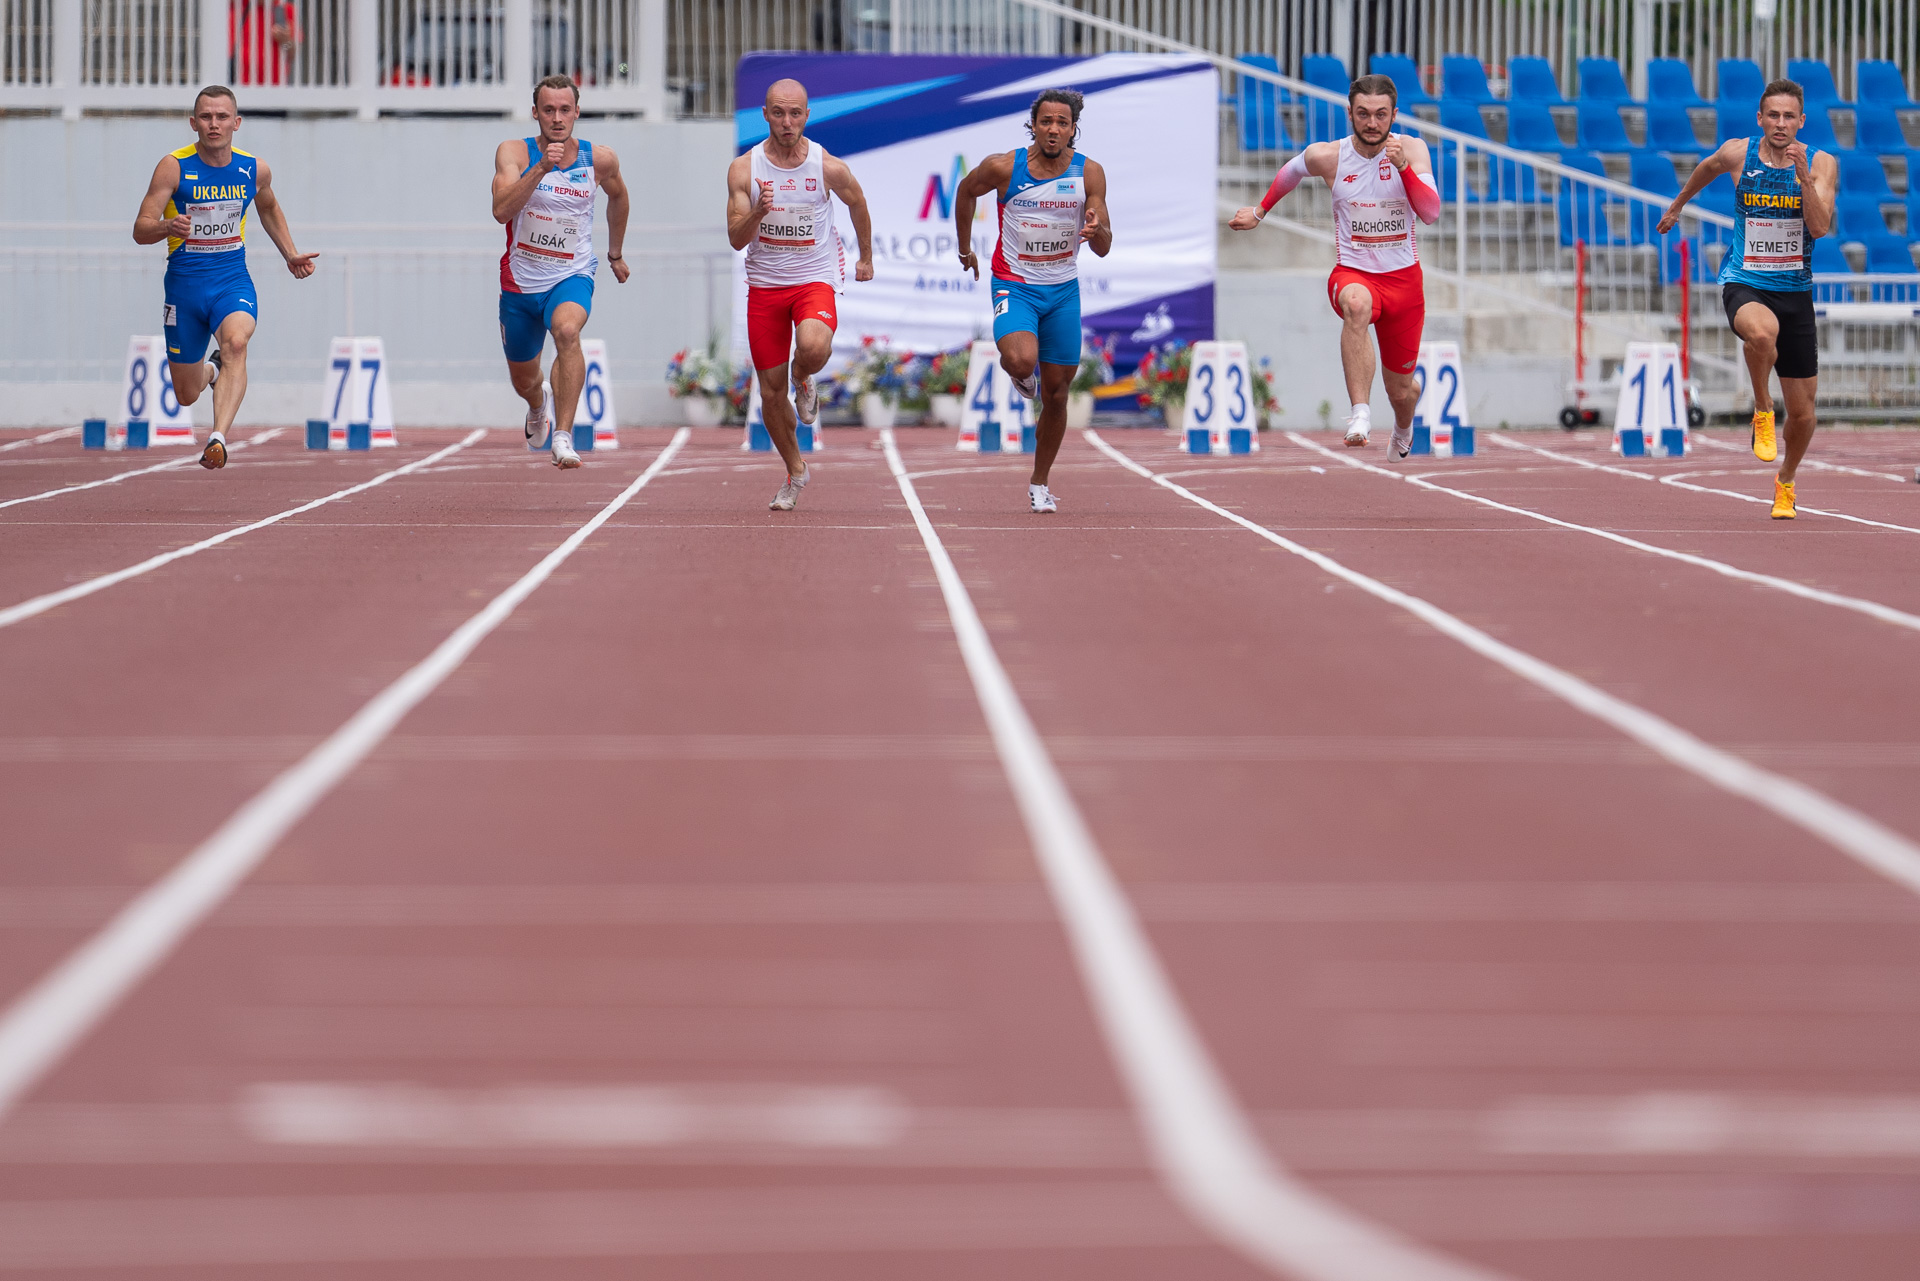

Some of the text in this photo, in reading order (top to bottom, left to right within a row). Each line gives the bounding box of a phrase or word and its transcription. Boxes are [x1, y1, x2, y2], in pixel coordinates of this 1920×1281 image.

[193, 185, 248, 200] UKRAINE
[536, 183, 589, 198] ECH REPUBLIC
[1012, 199, 1038, 208] CZECH
[1744, 193, 1802, 209] UKRAINE
[194, 222, 234, 236] POPOV
[760, 222, 812, 236] REMBISZ
[1352, 218, 1404, 232] BACHÓRSKI
[530, 232, 566, 248] LISÁK
[1026, 240, 1068, 252] NTEMO
[1749, 240, 1798, 252] YEMETS
[164, 305, 172, 324] 7
[995, 302, 1004, 316] 4
[128, 358, 147, 417] 8
[160, 358, 180, 418] 8
[332, 359, 351, 420] 7
[361, 359, 380, 420] 7
[585, 362, 604, 422] 6
[971, 362, 995, 424] 4
[1192, 363, 1214, 423] 3
[1228, 363, 1246, 423] 3
[1437, 364, 1460, 428] 2
[1630, 363, 1647, 427] 1
[1662, 363, 1676, 427] 1
